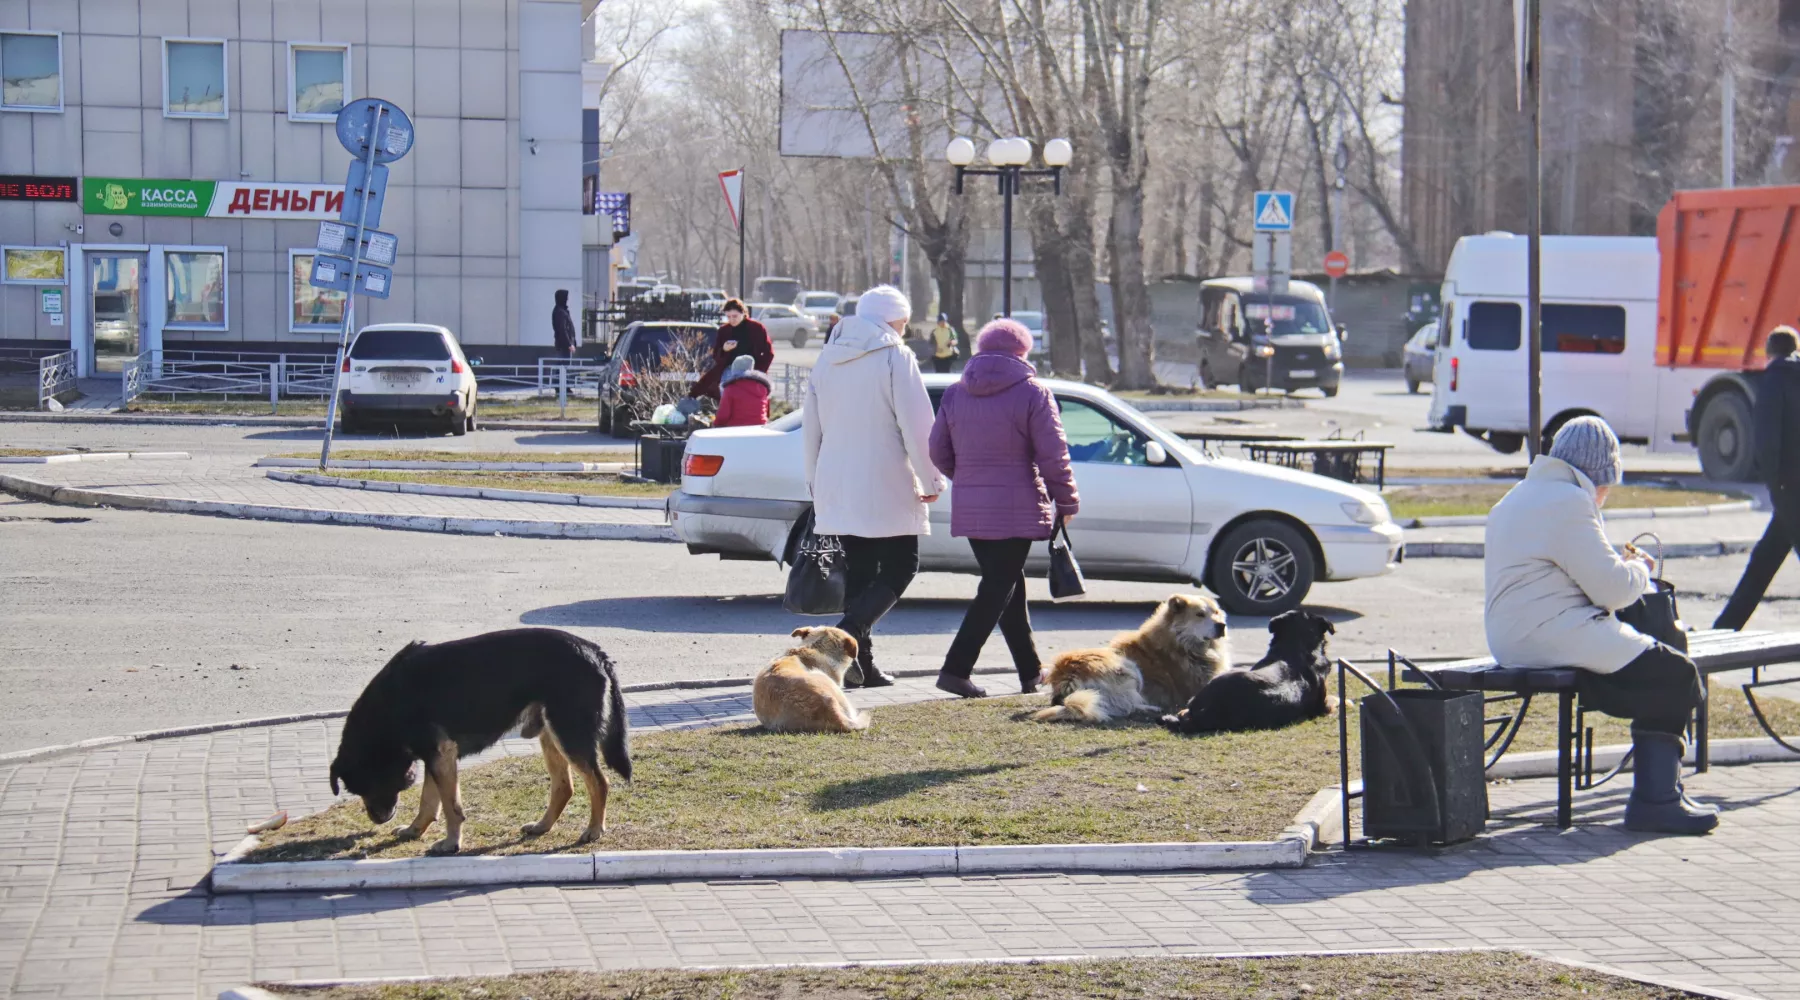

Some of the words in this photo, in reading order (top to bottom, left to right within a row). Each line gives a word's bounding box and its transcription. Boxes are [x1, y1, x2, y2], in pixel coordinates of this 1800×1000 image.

[25, 184, 71, 198] ВОЛ
[141, 188, 198, 203] КАССА
[228, 188, 344, 214] ДЕНЬГИ
